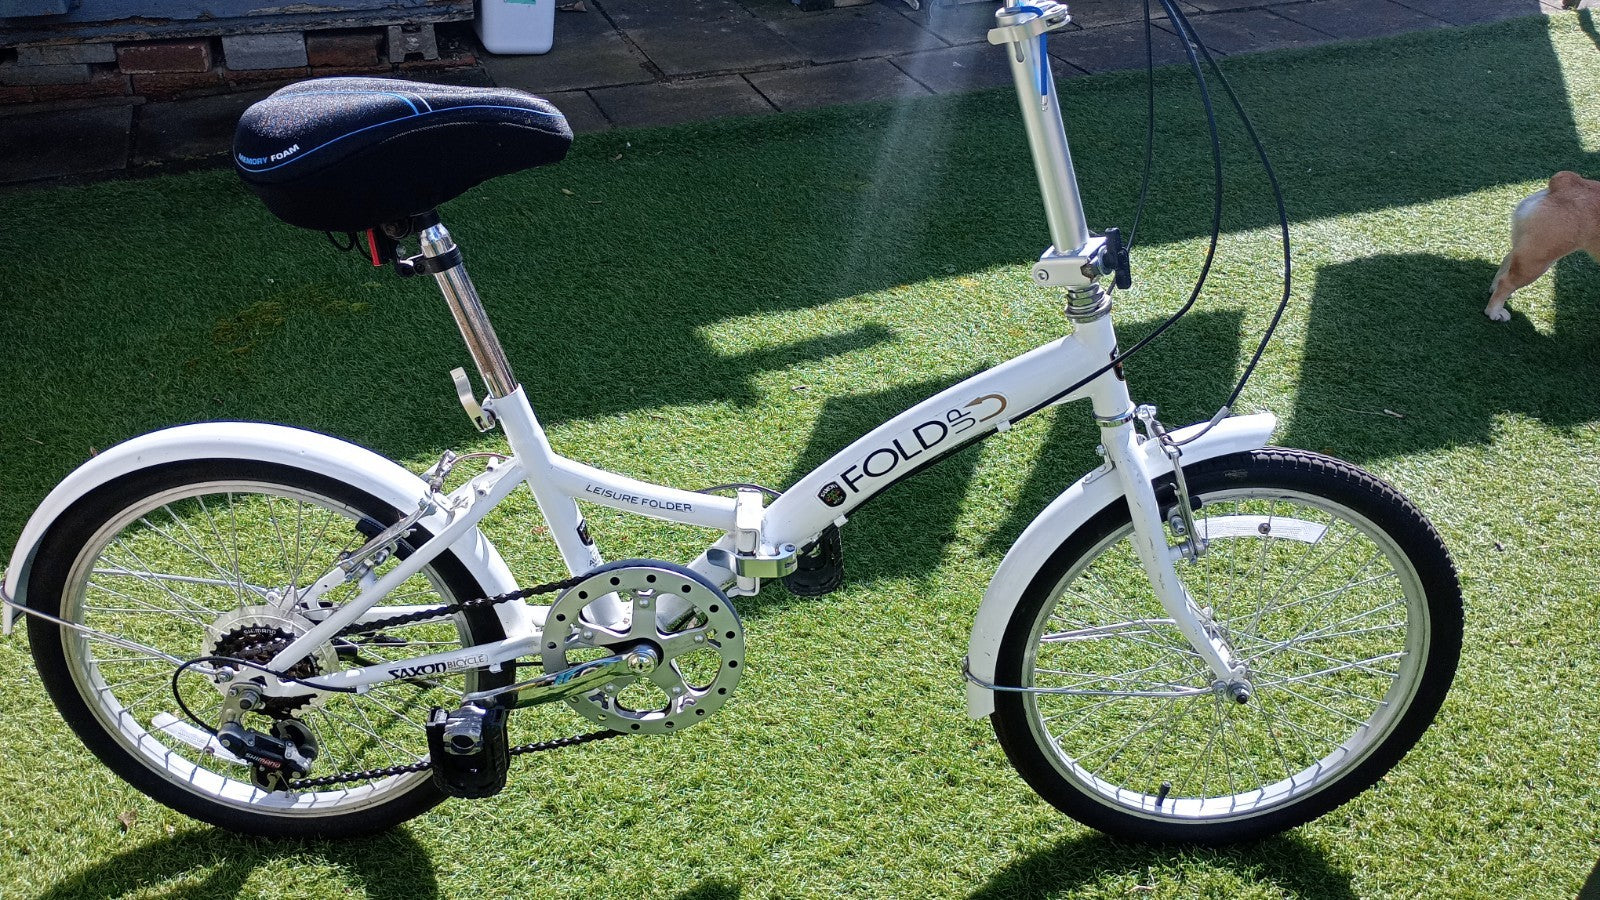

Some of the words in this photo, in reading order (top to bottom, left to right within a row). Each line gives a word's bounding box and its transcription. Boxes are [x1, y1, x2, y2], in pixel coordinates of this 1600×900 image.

[238, 152, 268, 165] MEMORY
[270, 144, 299, 161] FOAM
[840, 420, 948, 493] FOLD
[946, 408, 975, 434] UP
[585, 484, 638, 504] LEISURE
[641, 498, 693, 512] FOLDER
[388, 662, 447, 680] SAXON
[447, 655, 485, 668] BICYCLE
